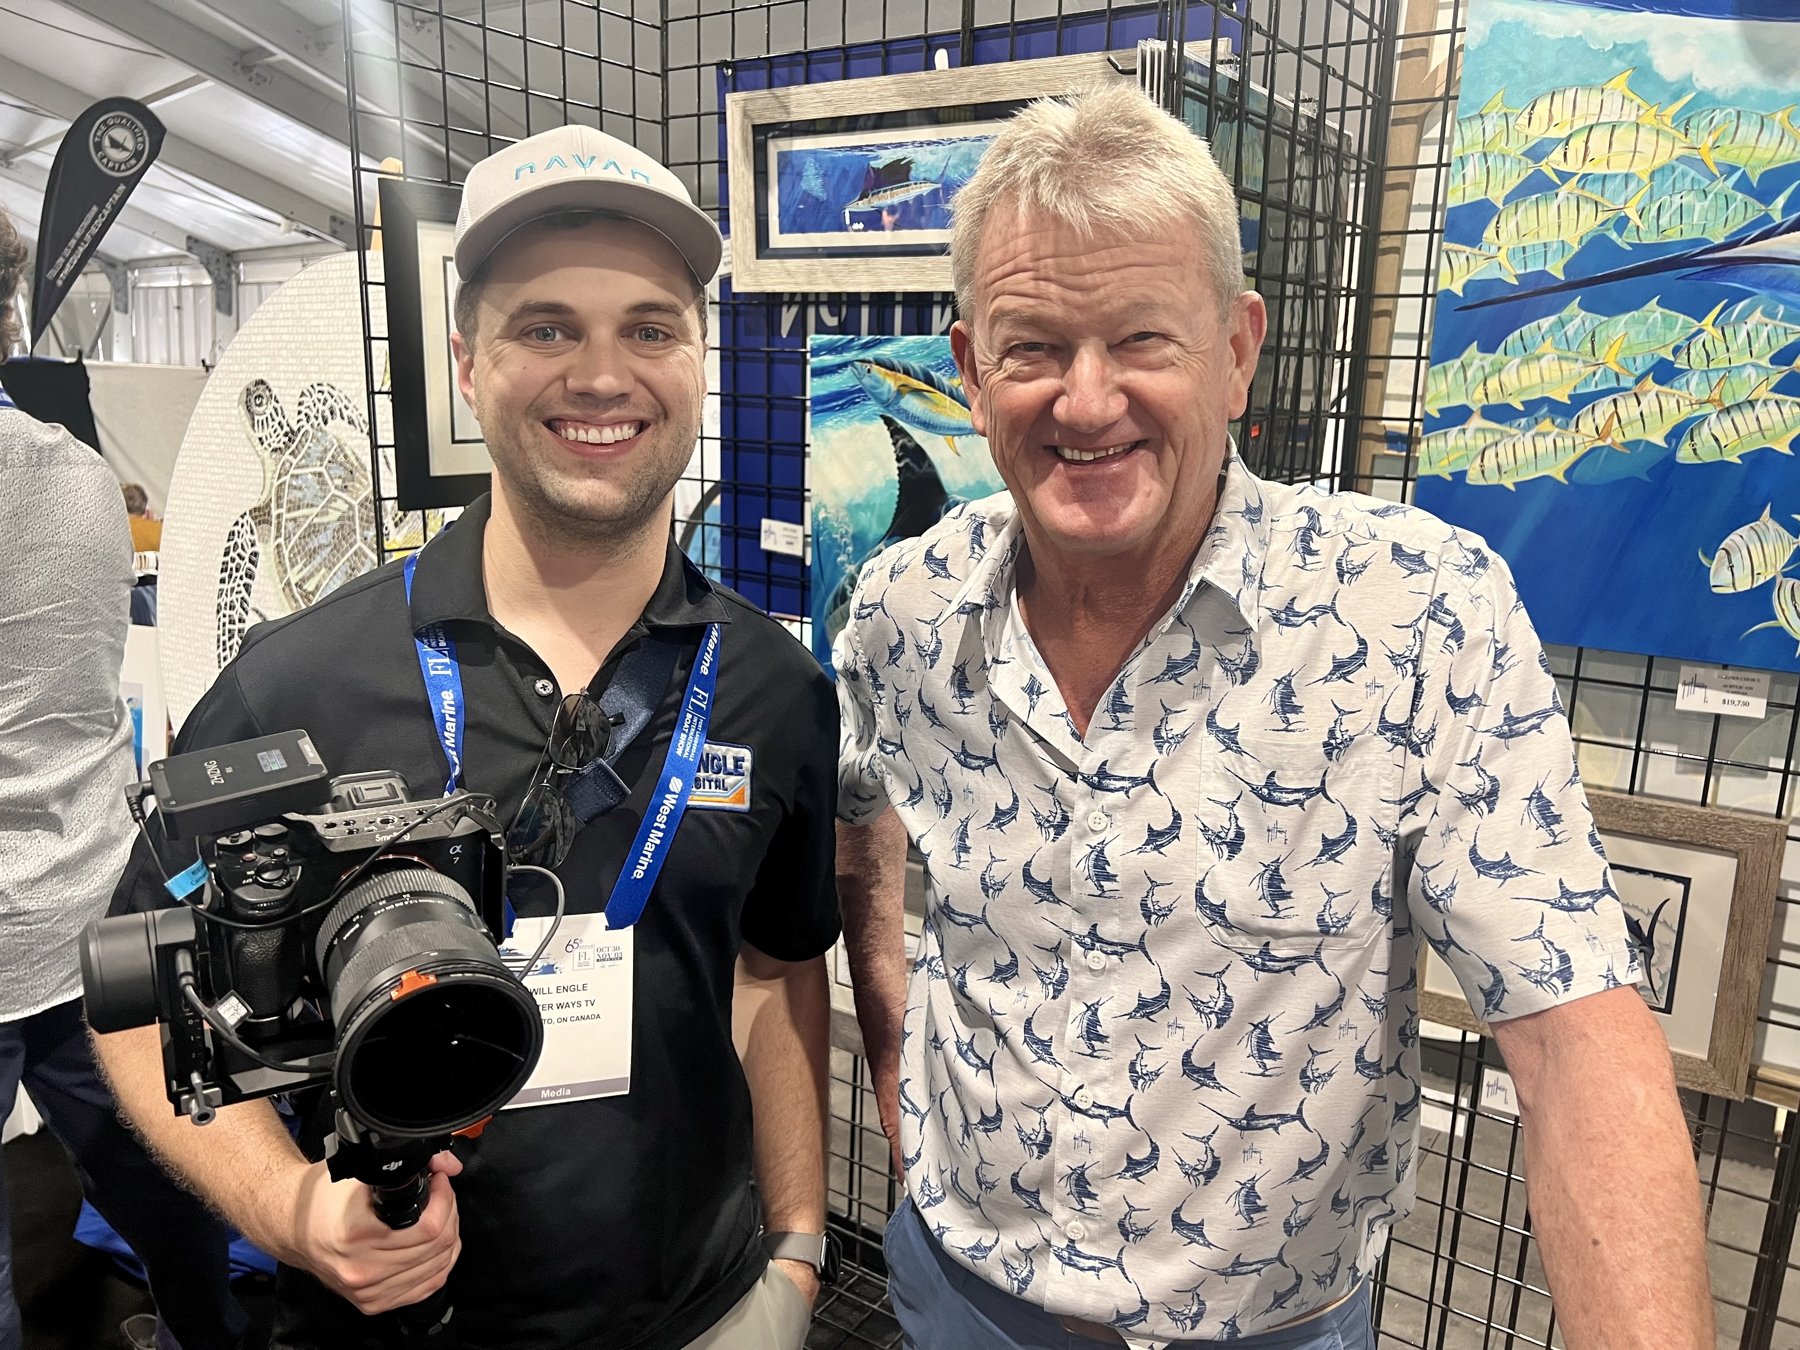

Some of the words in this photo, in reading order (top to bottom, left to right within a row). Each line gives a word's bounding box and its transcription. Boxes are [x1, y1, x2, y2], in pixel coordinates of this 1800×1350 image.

[94, 122, 107, 142] THE
[106, 115, 144, 151] QUALIFIED
[97, 151, 137, 171] CAPTAIN
[700, 626, 719, 676] Marine
[427, 651, 452, 677] FL
[688, 684, 709, 711] FL
[440, 690, 457, 748] Marine
[682, 713, 692, 733] BOAT
[675, 732, 687, 757] SHOW
[696, 752, 745, 777] NGLE
[691, 776, 728, 791] GITAL
[653, 793, 679, 830] West
[453, 856, 460, 864] 7
[632, 829, 664, 880] Marine
[529, 986, 553, 995] WILL
[556, 983, 588, 994] ENGLE
[556, 1000, 582, 1010] WAYS
[584, 999, 596, 1007] TV
[556, 1016, 568, 1024] ON
[569, 1013, 601, 1022] CANADA
[541, 1087, 571, 1098] Media
